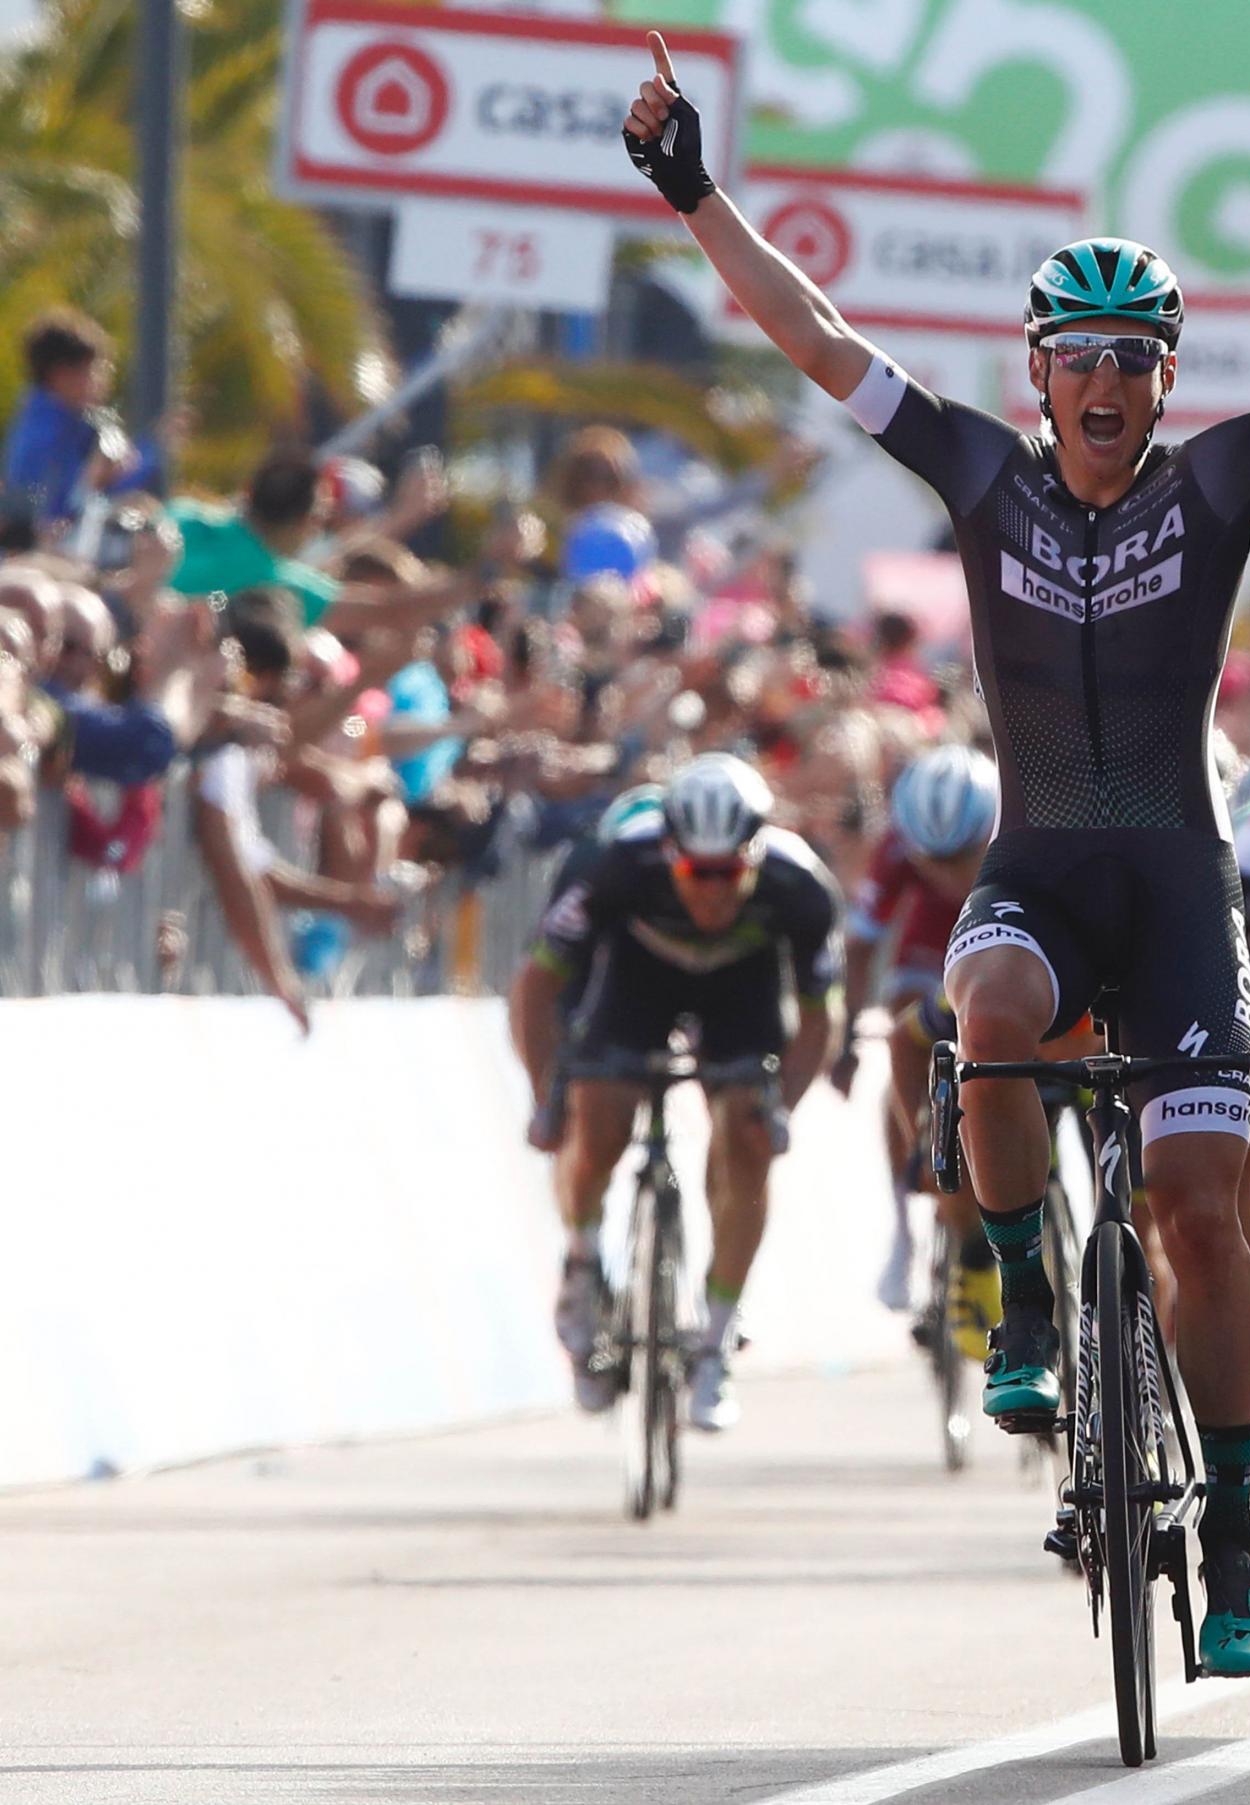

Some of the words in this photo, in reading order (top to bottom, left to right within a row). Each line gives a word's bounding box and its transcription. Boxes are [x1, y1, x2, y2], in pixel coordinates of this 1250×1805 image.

[1014, 474, 1060, 520] CRAFT
[1032, 503, 1186, 587] BORA
[1022, 566, 1163, 620] hansgrohe
[947, 926, 1031, 962] grohe
[1075, 1301, 1093, 1457] SPECIALIZED
[1137, 1290, 1165, 1446] SPECIALIZED
